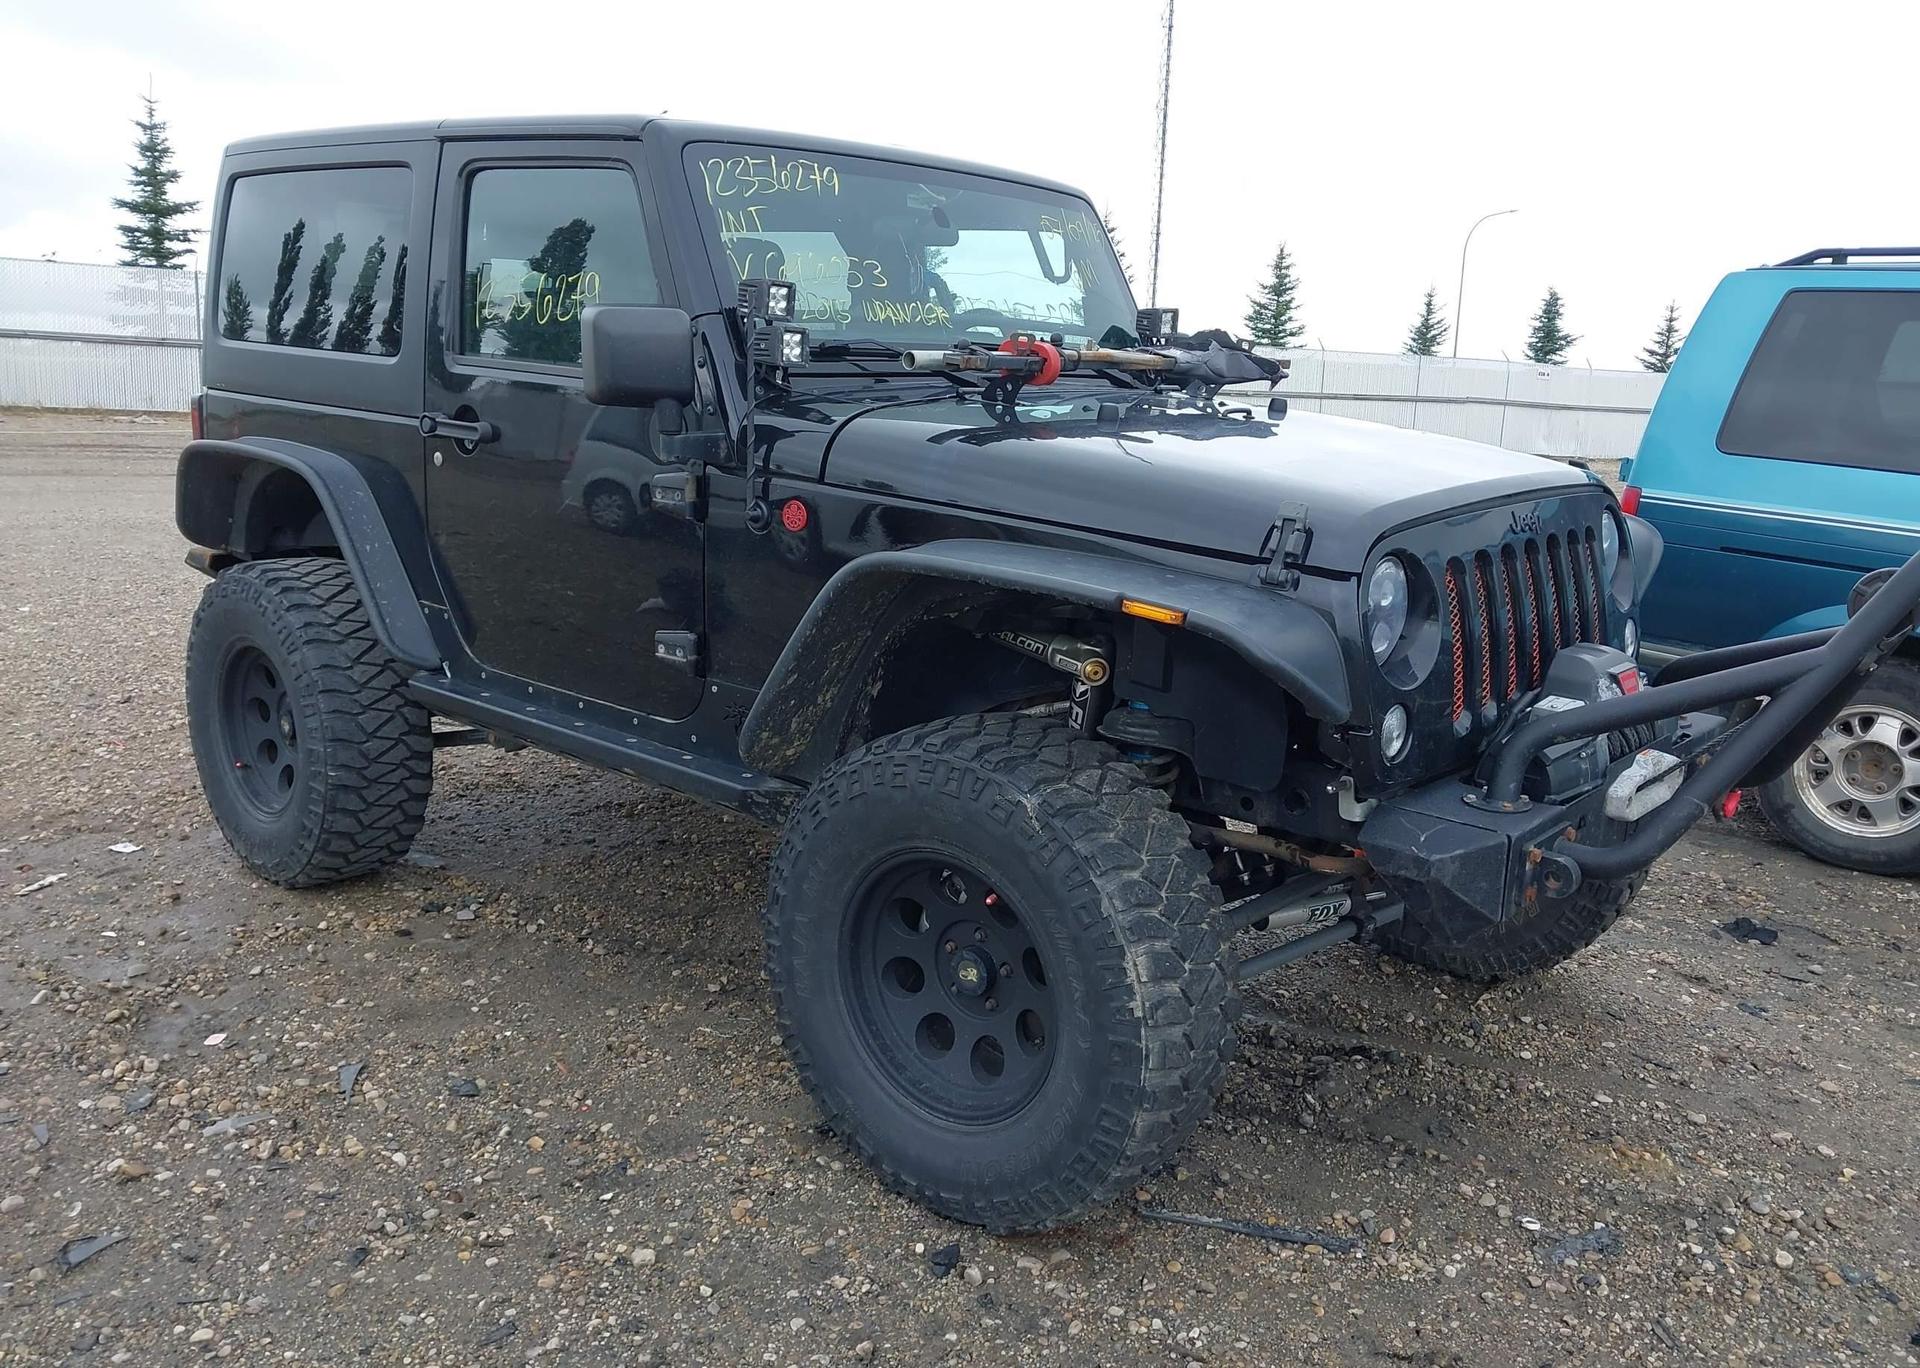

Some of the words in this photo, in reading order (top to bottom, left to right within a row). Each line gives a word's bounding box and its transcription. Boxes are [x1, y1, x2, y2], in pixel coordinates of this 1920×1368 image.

[699, 154, 839, 205] 12356279
[718, 205, 768, 249] INT
[1508, 510, 1541, 535] Jeep
[992, 630, 1045, 655] ALCON
[1307, 899, 1348, 922] FOX
